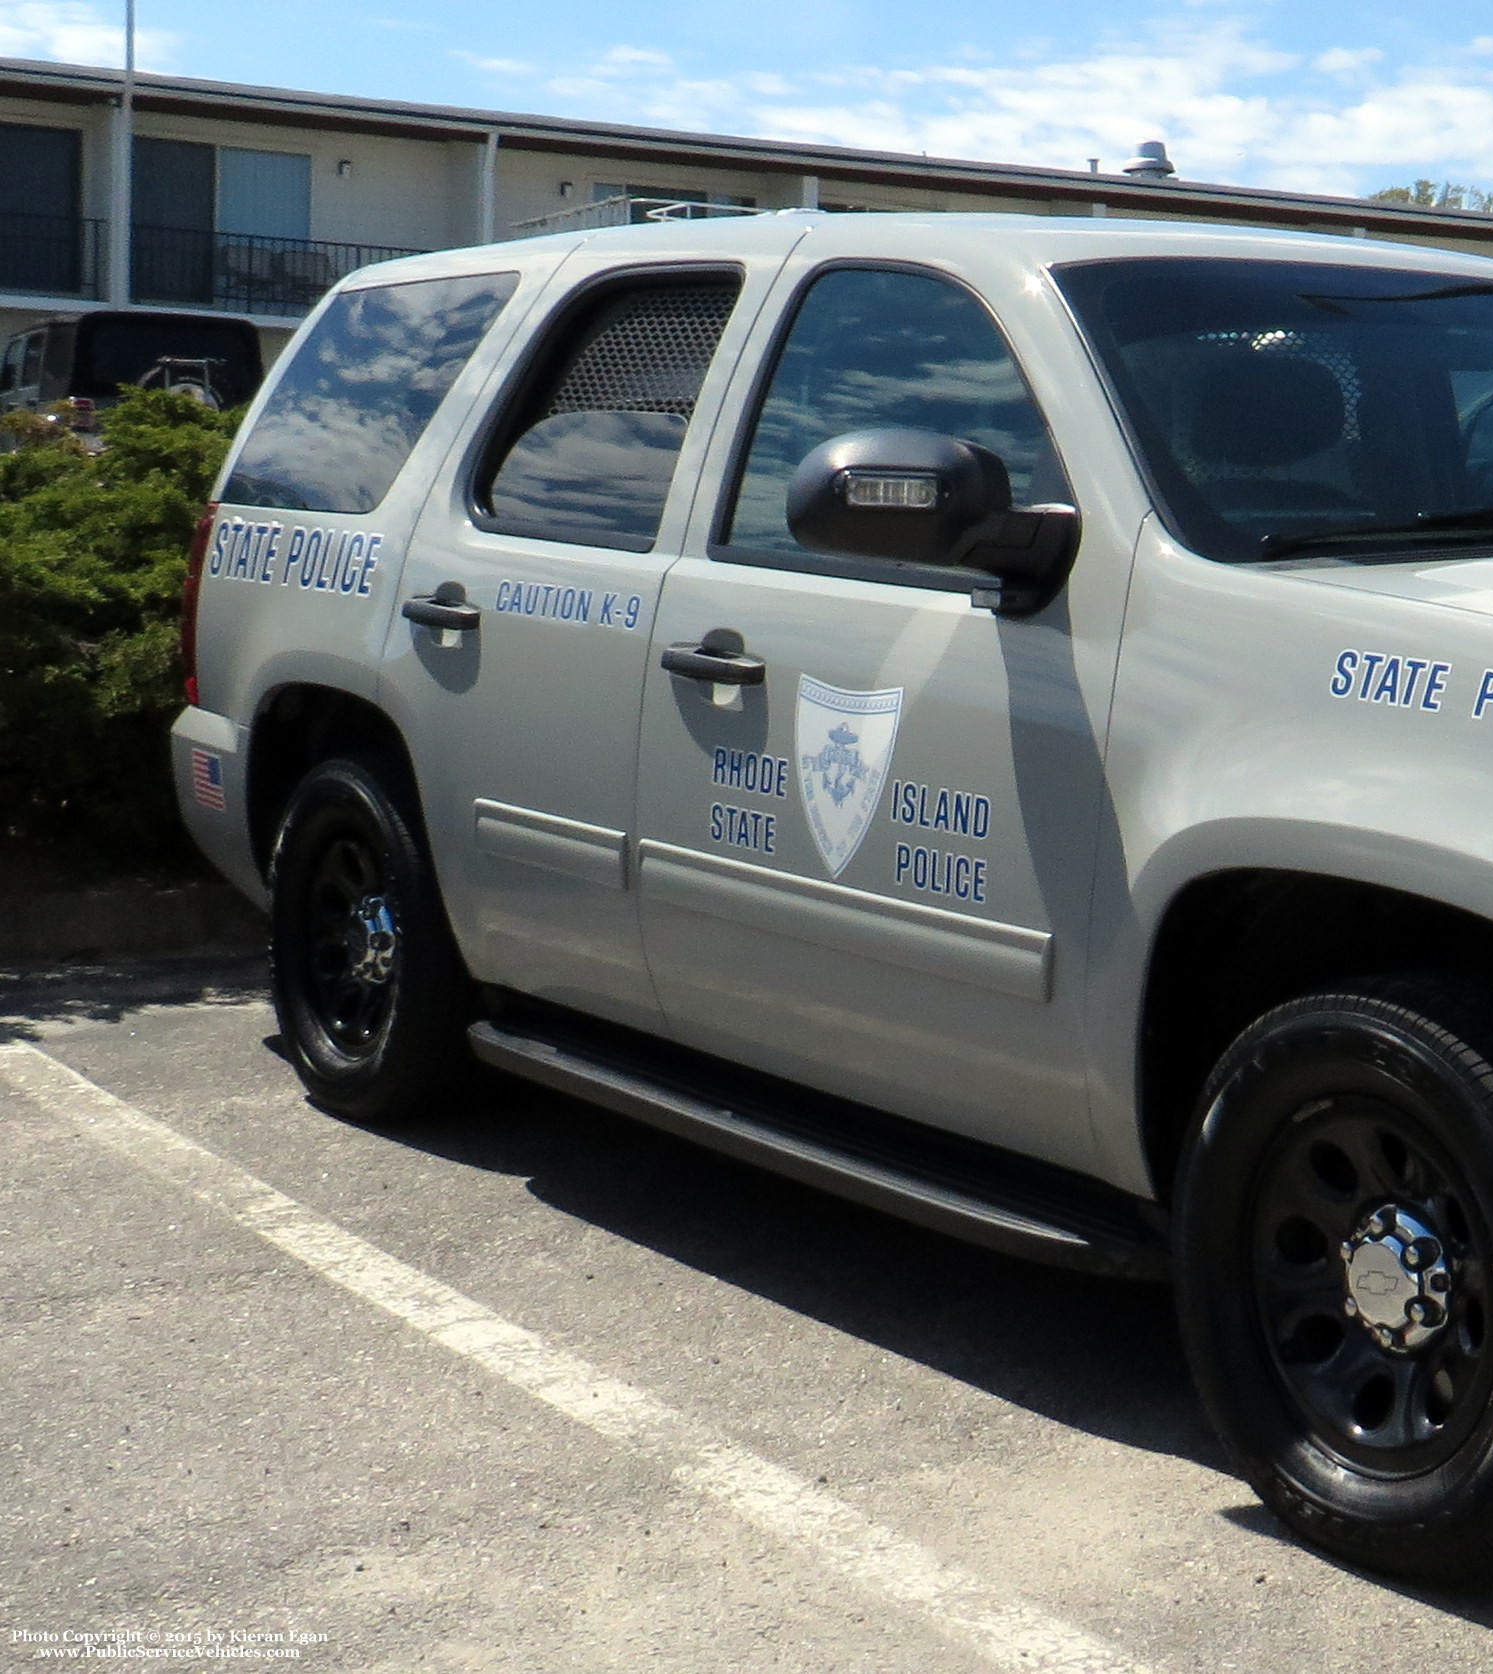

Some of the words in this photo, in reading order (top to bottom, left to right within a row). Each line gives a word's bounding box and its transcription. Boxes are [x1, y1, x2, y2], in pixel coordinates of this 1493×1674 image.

[211, 519, 282, 584] STATE
[283, 526, 383, 597] POLICE
[495, 578, 590, 625] CAUTION
[600, 594, 641, 631] K-9
[1331, 649, 1452, 713] STATE
[713, 748, 788, 798] RHODE
[891, 779, 990, 839] ISLAND
[711, 803, 776, 853] STATE
[895, 843, 987, 903] POLICE
